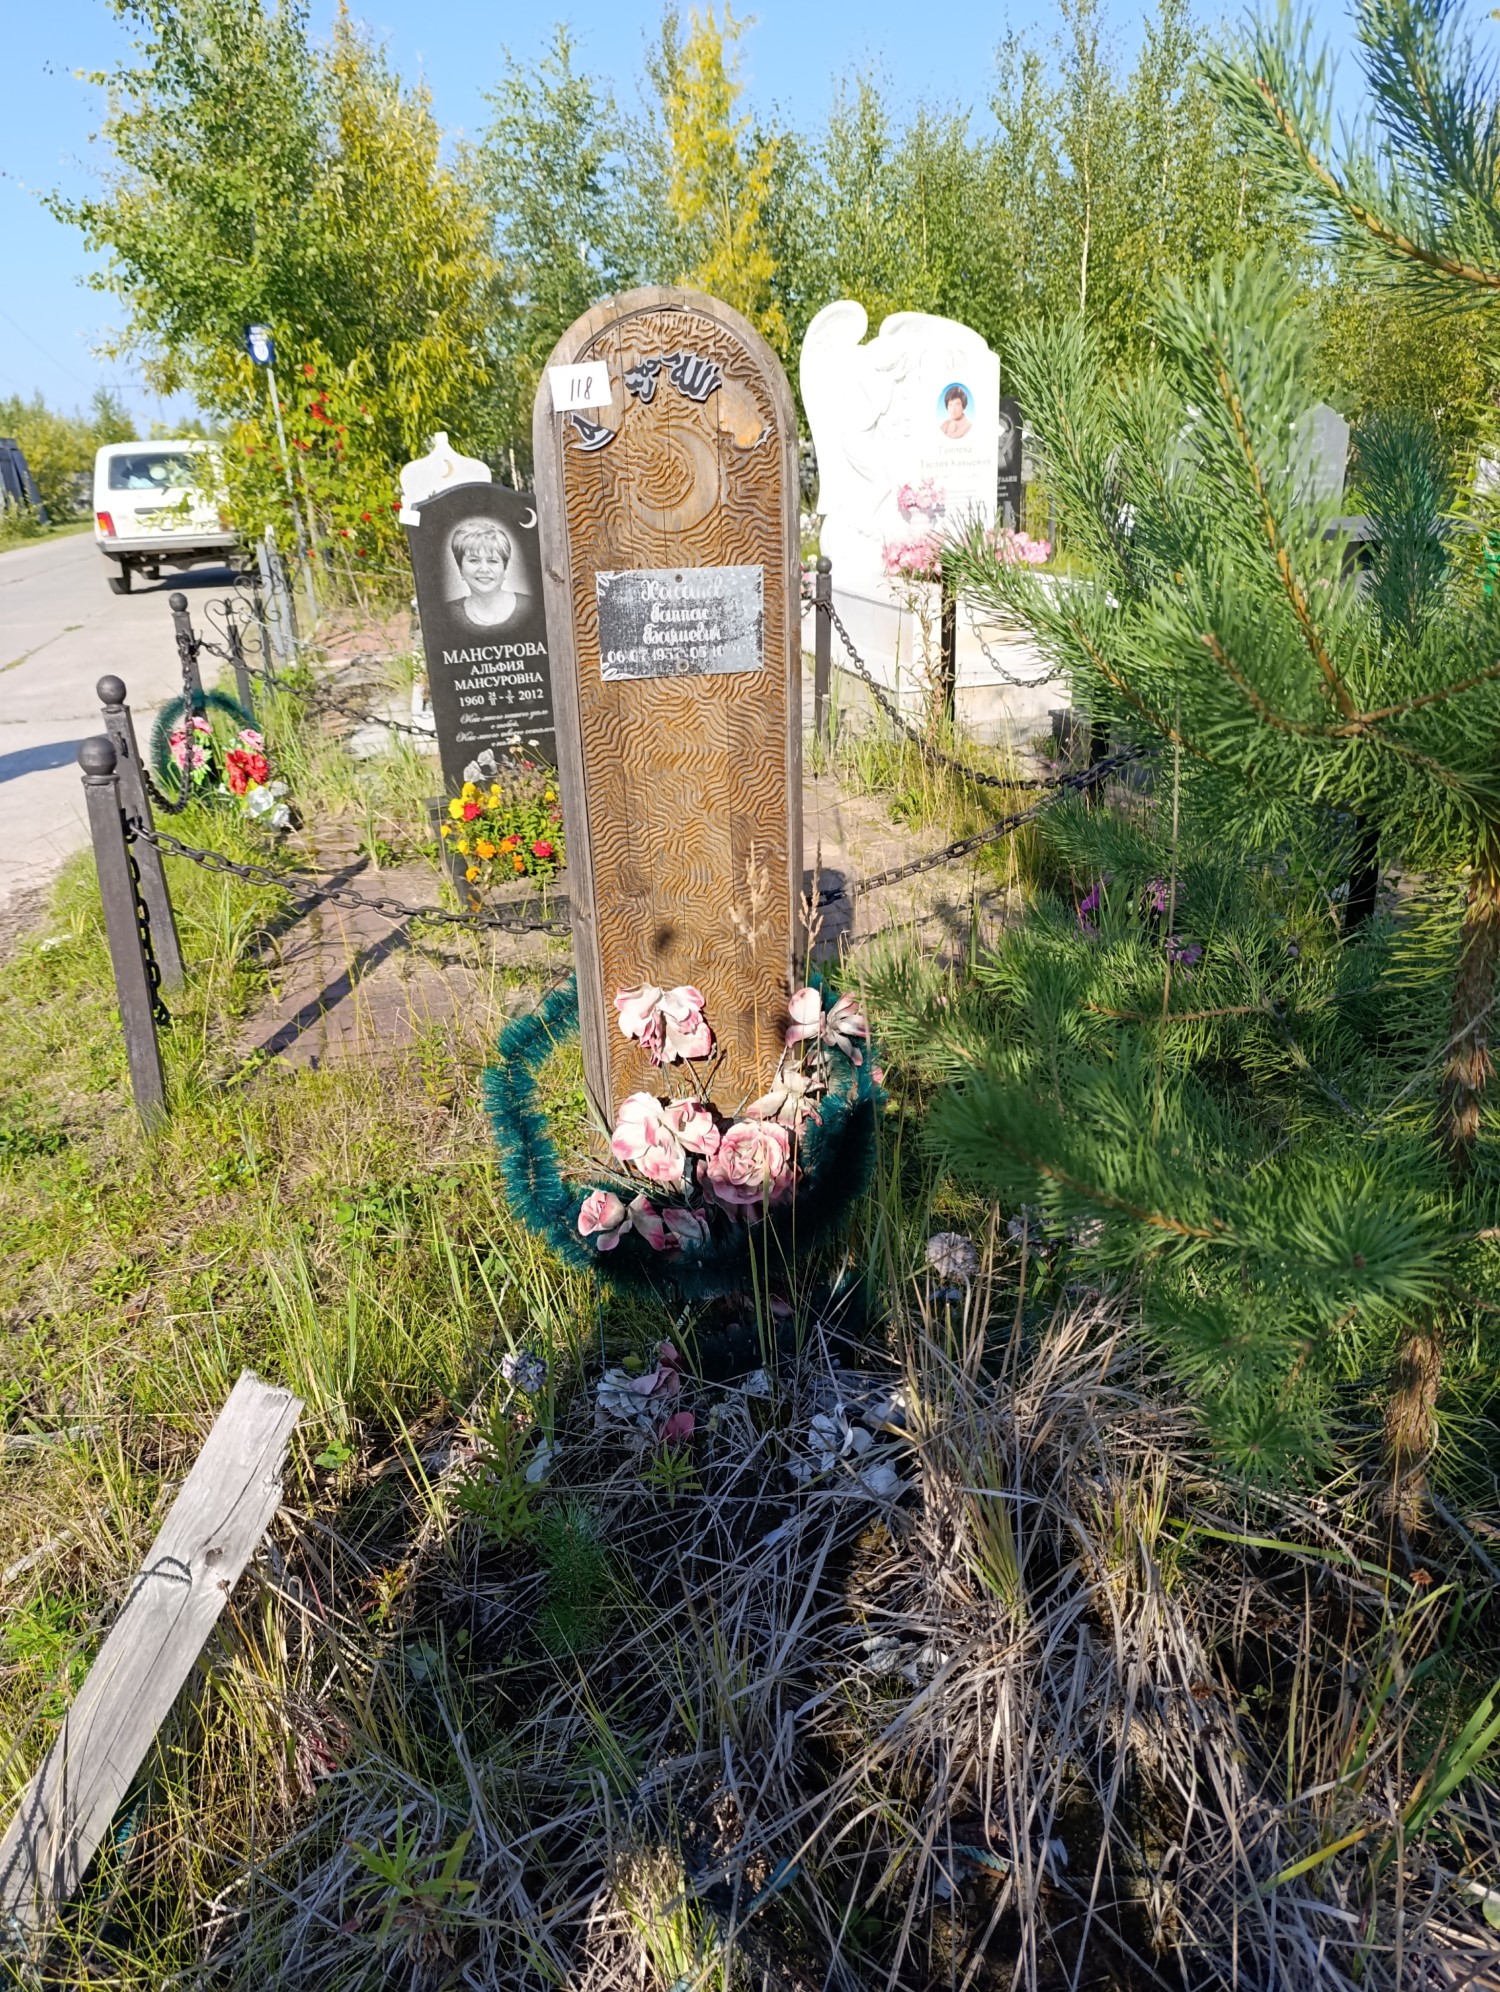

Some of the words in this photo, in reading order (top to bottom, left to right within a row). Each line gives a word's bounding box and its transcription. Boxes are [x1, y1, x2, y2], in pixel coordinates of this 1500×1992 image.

[570, 376, 593, 402] 118
[442, 641, 548, 665] МАНСУРОВА
[470, 660, 525, 676] АЛЬФИЯ
[454, 671, 544, 691] МАНСУРОВНА
[459, 695, 485, 707] 1960
[518, 688, 544, 701] 2012
